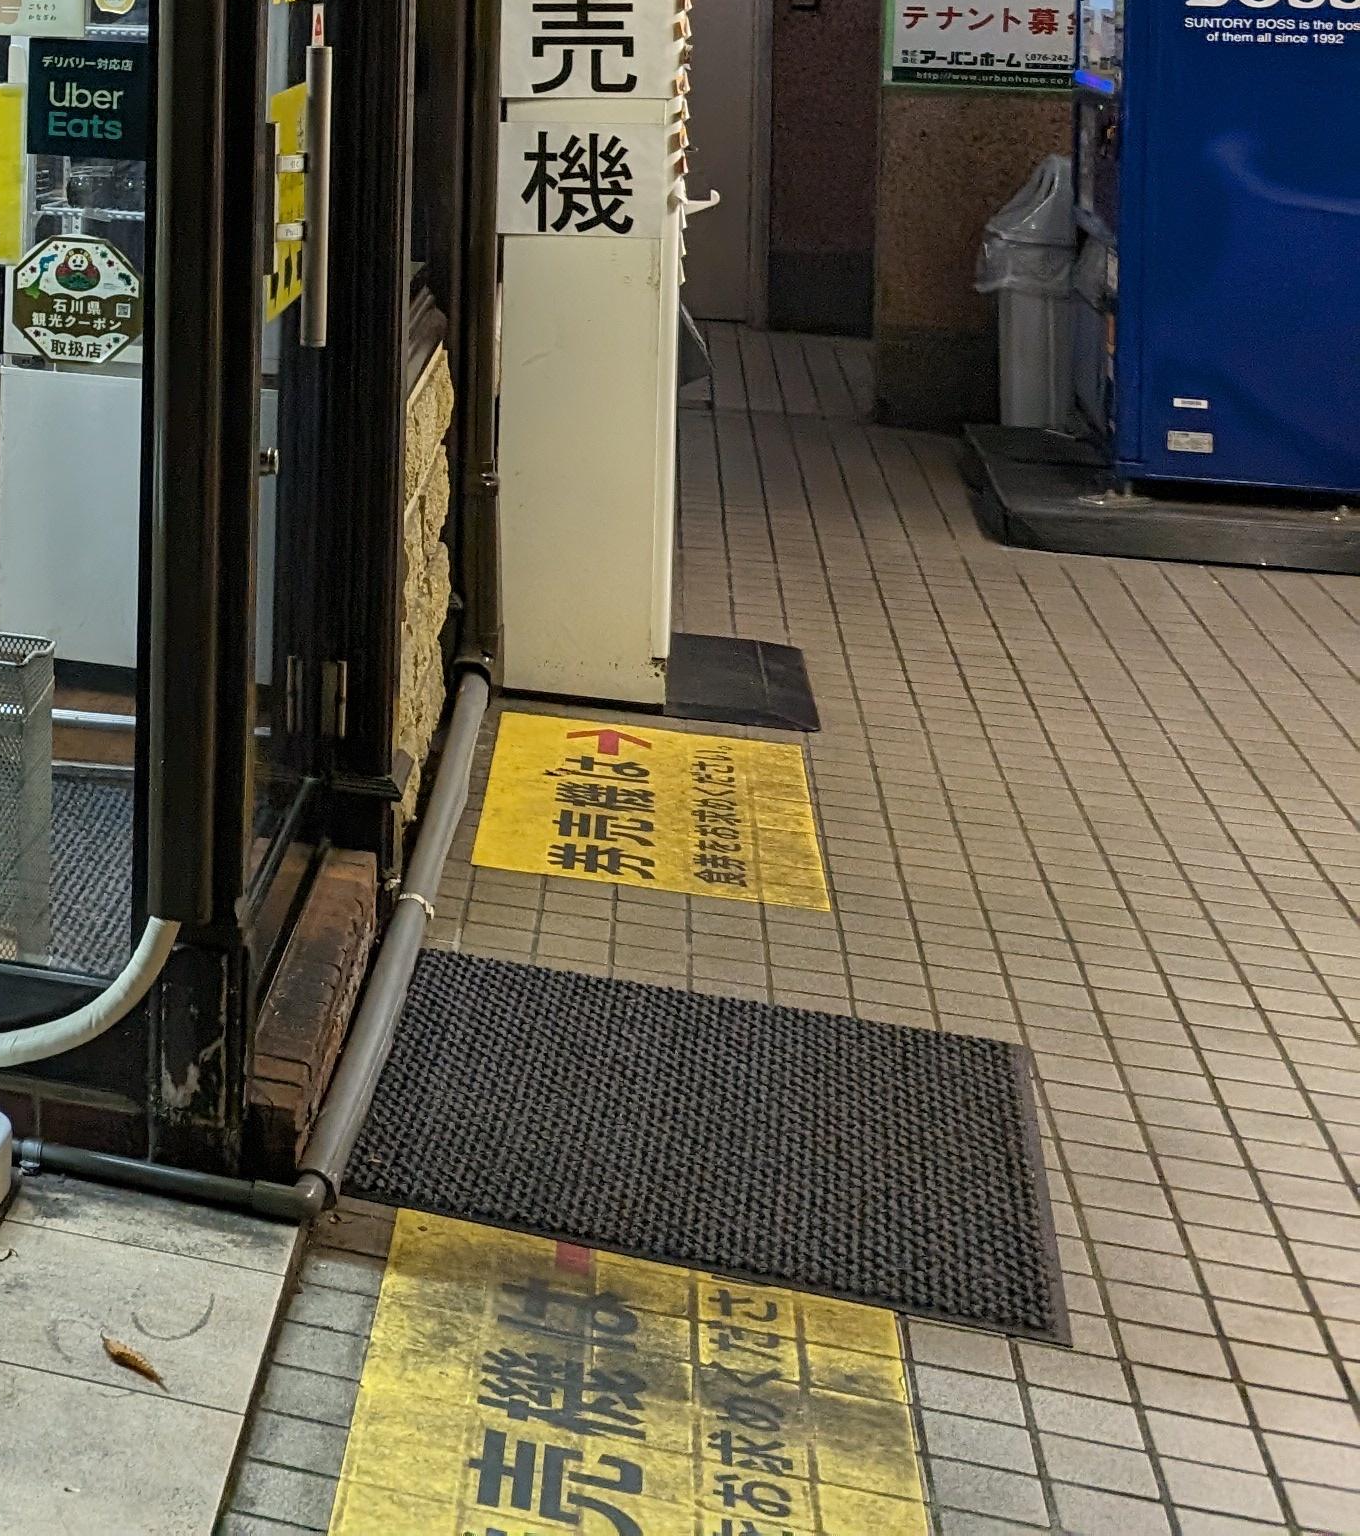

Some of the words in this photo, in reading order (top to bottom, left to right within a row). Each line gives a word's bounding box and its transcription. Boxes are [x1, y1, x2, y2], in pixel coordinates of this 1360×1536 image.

[1184, 17, 1253, 30] SUNTORY
[1255, 18, 1296, 31] BOSS
[1298, 19, 1310, 31] is
[1312, 20, 1333, 31] the
[1206, 31, 1220, 42] of
[1221, 32, 1254, 43] them
[1256, 32, 1272, 43] all
[1274, 33, 1309, 44] since
[1312, 33, 1344, 44] 1992
[42, 55, 134, 72] デリバリー対応店
[919, 49, 1021, 68] アーバンホーム
[48, 80, 125, 111] Uber
[47, 111, 123, 140] Eats
[52, 297, 102, 316] 石川県
[31, 312, 122, 331] 観光クーポン
[50, 339, 103, 359] 取扱店
[546, 755, 656, 880] 券売機は
[688, 745, 749, 889] 食券をお求めください。
[466, 1275, 647, 1536] 売機は
